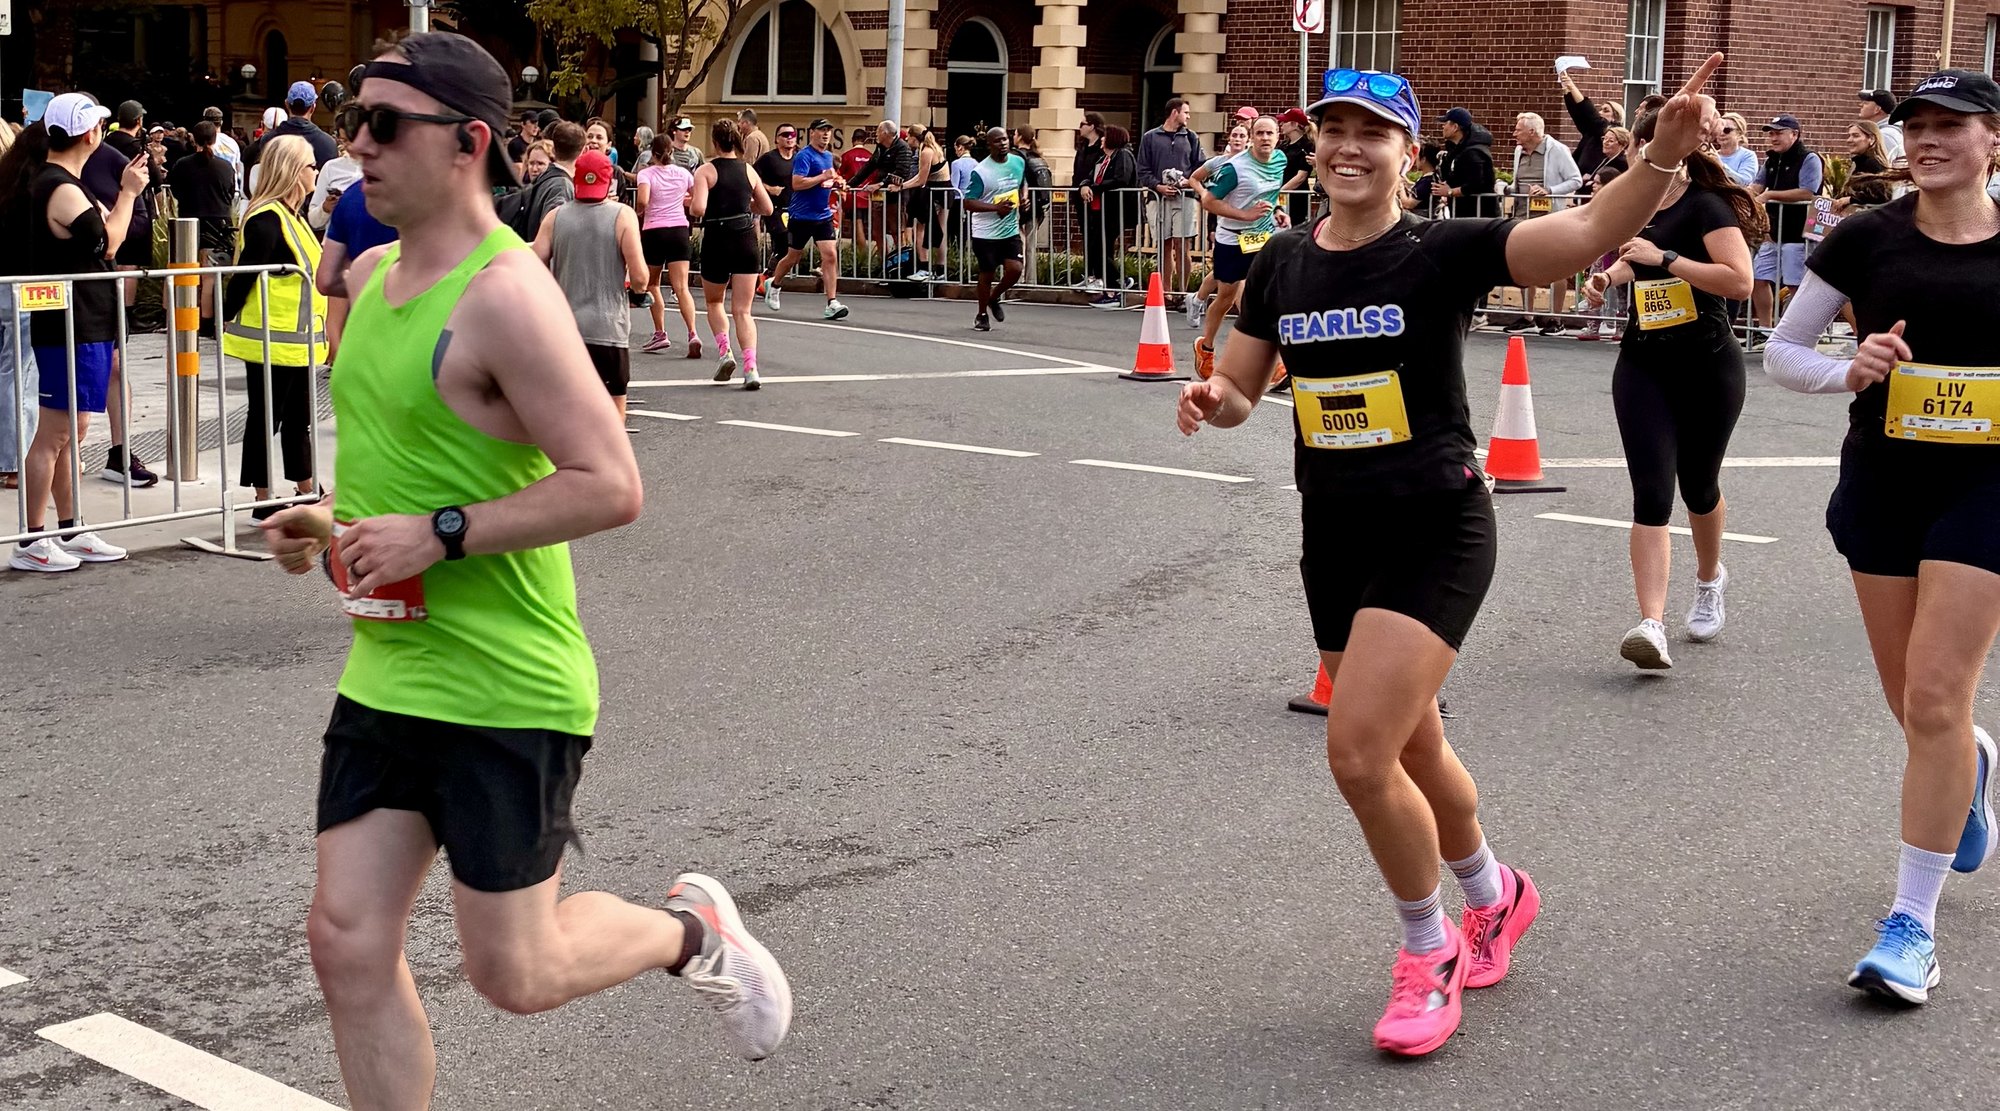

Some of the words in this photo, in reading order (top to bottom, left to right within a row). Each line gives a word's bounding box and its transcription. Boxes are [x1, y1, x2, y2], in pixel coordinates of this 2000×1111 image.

[1644, 289, 1668, 300] BELZ
[1644, 300, 1672, 312] 8663
[1279, 304, 1405, 345] FEARLSS
[1936, 382, 1966, 398] LIV
[1922, 398, 1974, 417] 6174
[1322, 412, 1369, 431] 6009
